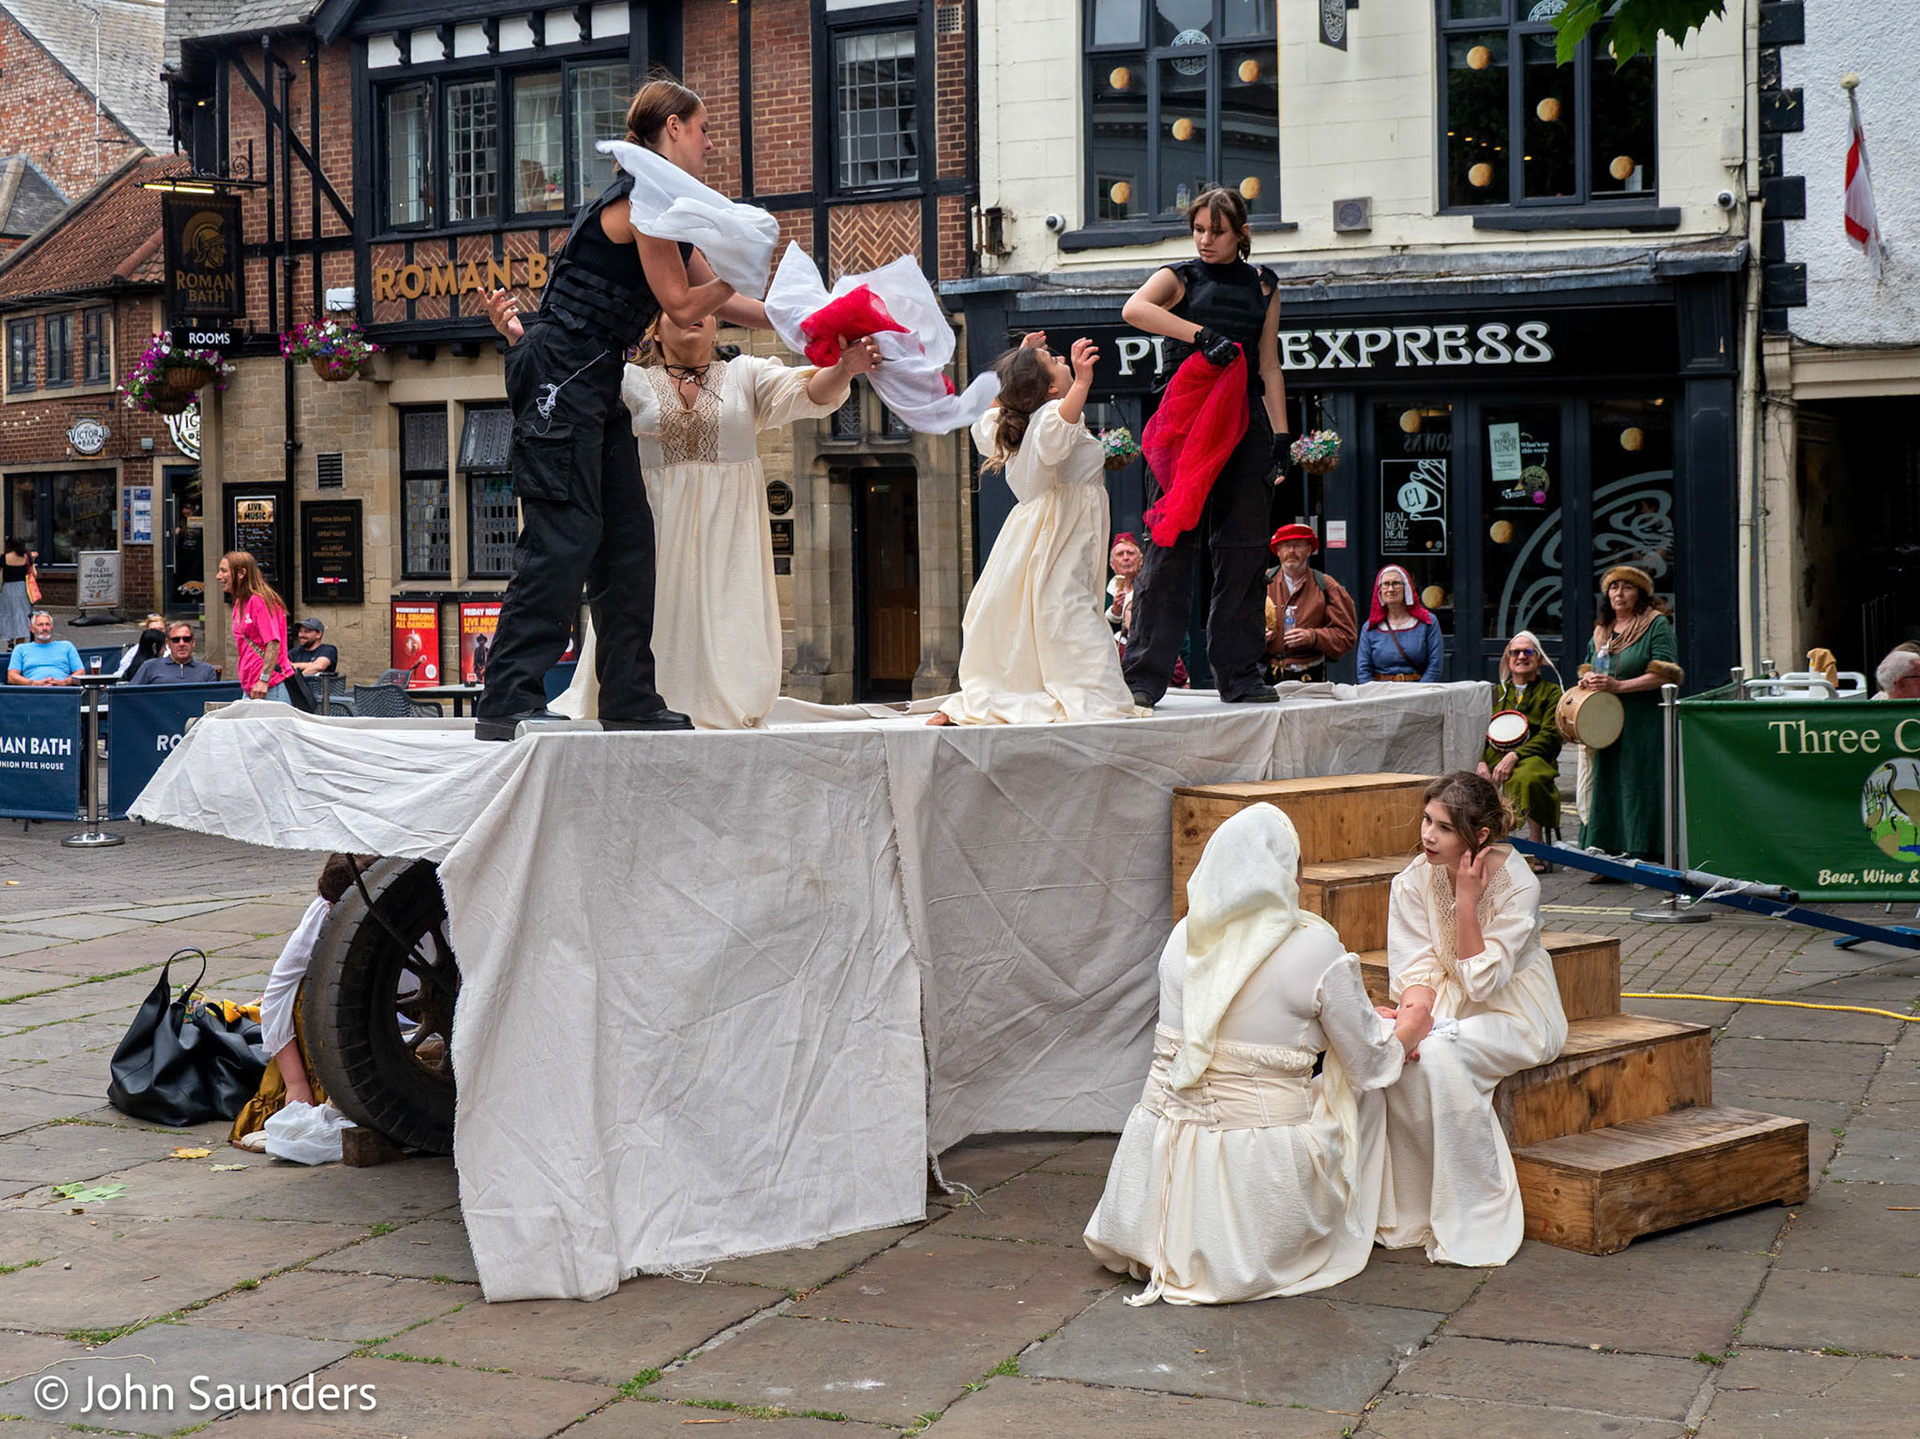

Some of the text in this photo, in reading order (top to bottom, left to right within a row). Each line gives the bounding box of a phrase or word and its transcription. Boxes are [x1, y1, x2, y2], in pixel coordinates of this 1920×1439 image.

[176, 270, 235, 291] ROMAN
[375, 254, 512, 301] ROMAN
[188, 289, 225, 303] BATH
[188, 332, 231, 345] ROOMS
[1279, 321, 1554, 371] EXPRESS
[69, 429, 99, 442] VICTOR
[82, 439, 97, 448] BAR
[1404, 487, 1422, 508] £1
[247, 503, 262, 511] LIVE
[243, 512, 266, 520] MUSIC
[395, 613, 407, 621] ALL
[463, 607, 502, 616] FRIDAY NIGH
[395, 620, 436, 629] ALL DANCING
[463, 617, 500, 626] LIVE MUS
[1768, 719, 1881, 754] Three
[30, 737, 71, 756] BATH
[21, 761, 39, 770] FREE
[39, 762, 65, 771] HOUSE
[1818, 868, 1920, 886] Beer, Wine &
